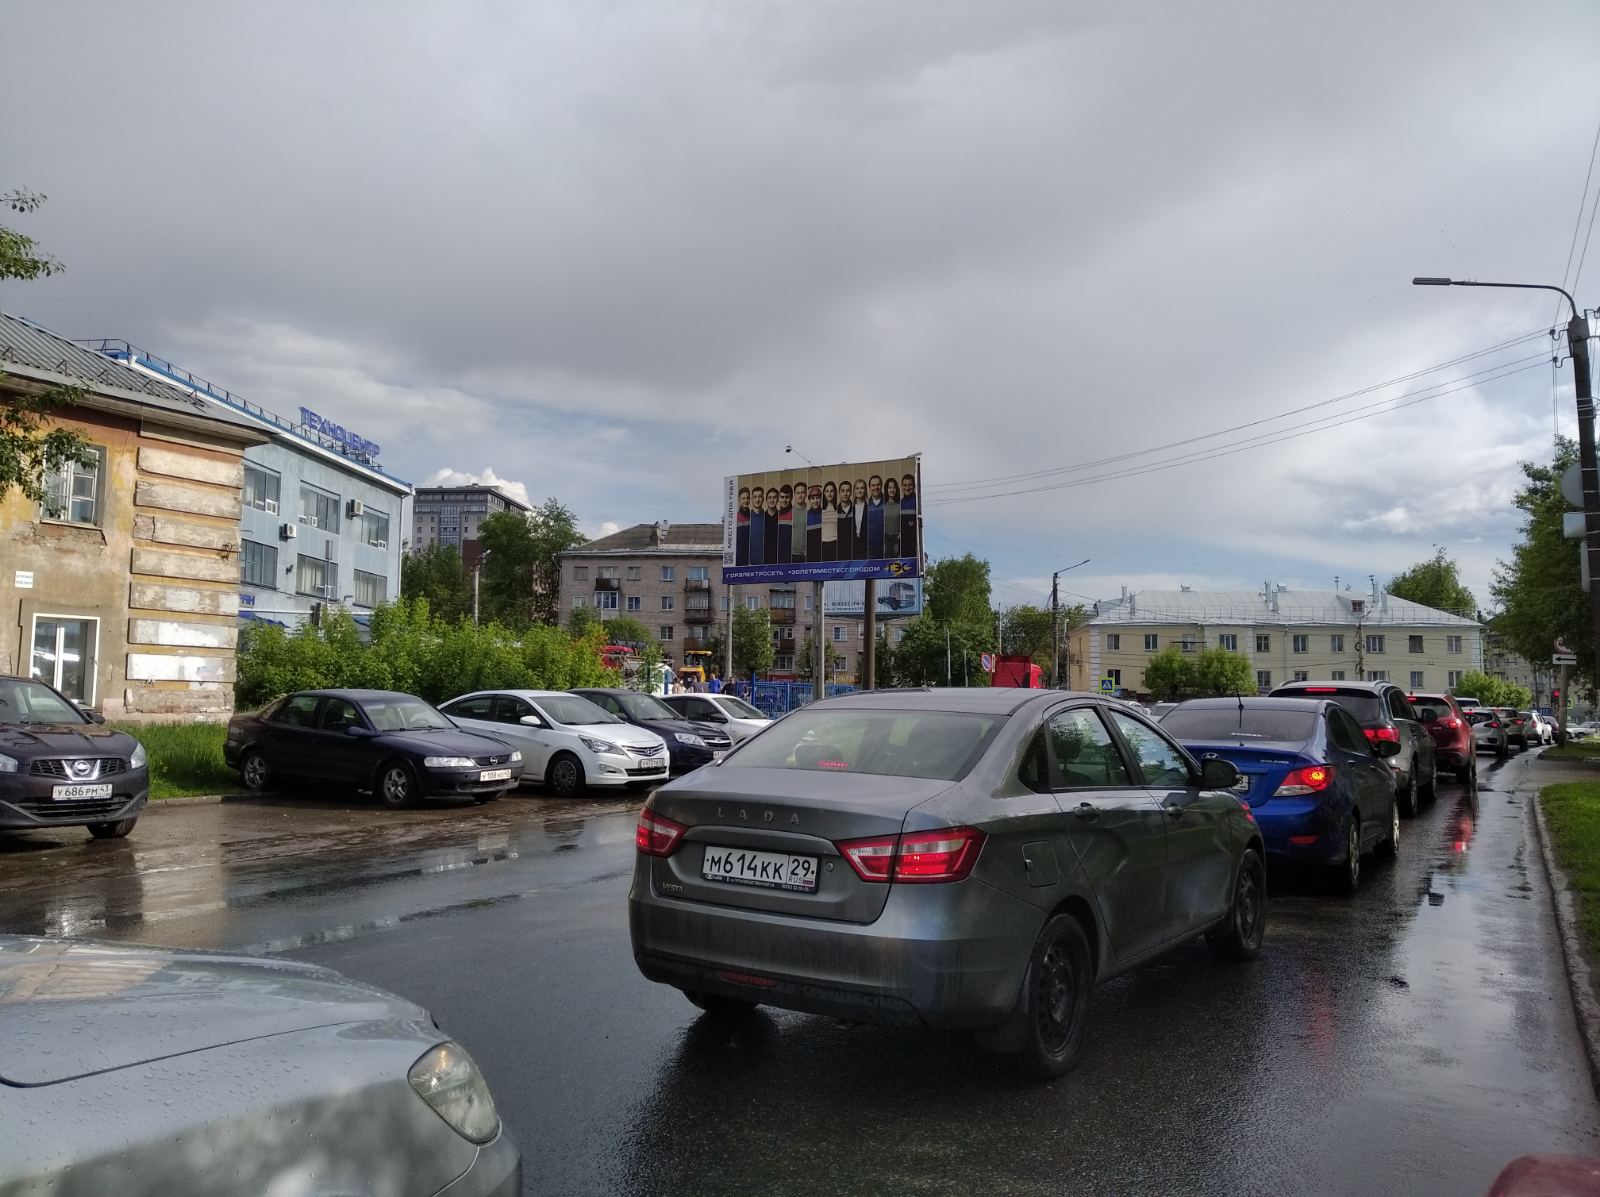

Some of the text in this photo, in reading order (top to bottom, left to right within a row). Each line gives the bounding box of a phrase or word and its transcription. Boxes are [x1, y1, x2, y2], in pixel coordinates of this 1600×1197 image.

[299, 406, 380, 457] ТЕХНОЦЕНТР
[726, 570, 784, 578] ГОРЭЛЕКТРОСЕТЬ
[889, 562, 910, 573] ГЭС
[718, 806, 800, 824] LADA
[709, 852, 811, 880] М614КК 29
[788, 876, 803, 884] RUS
